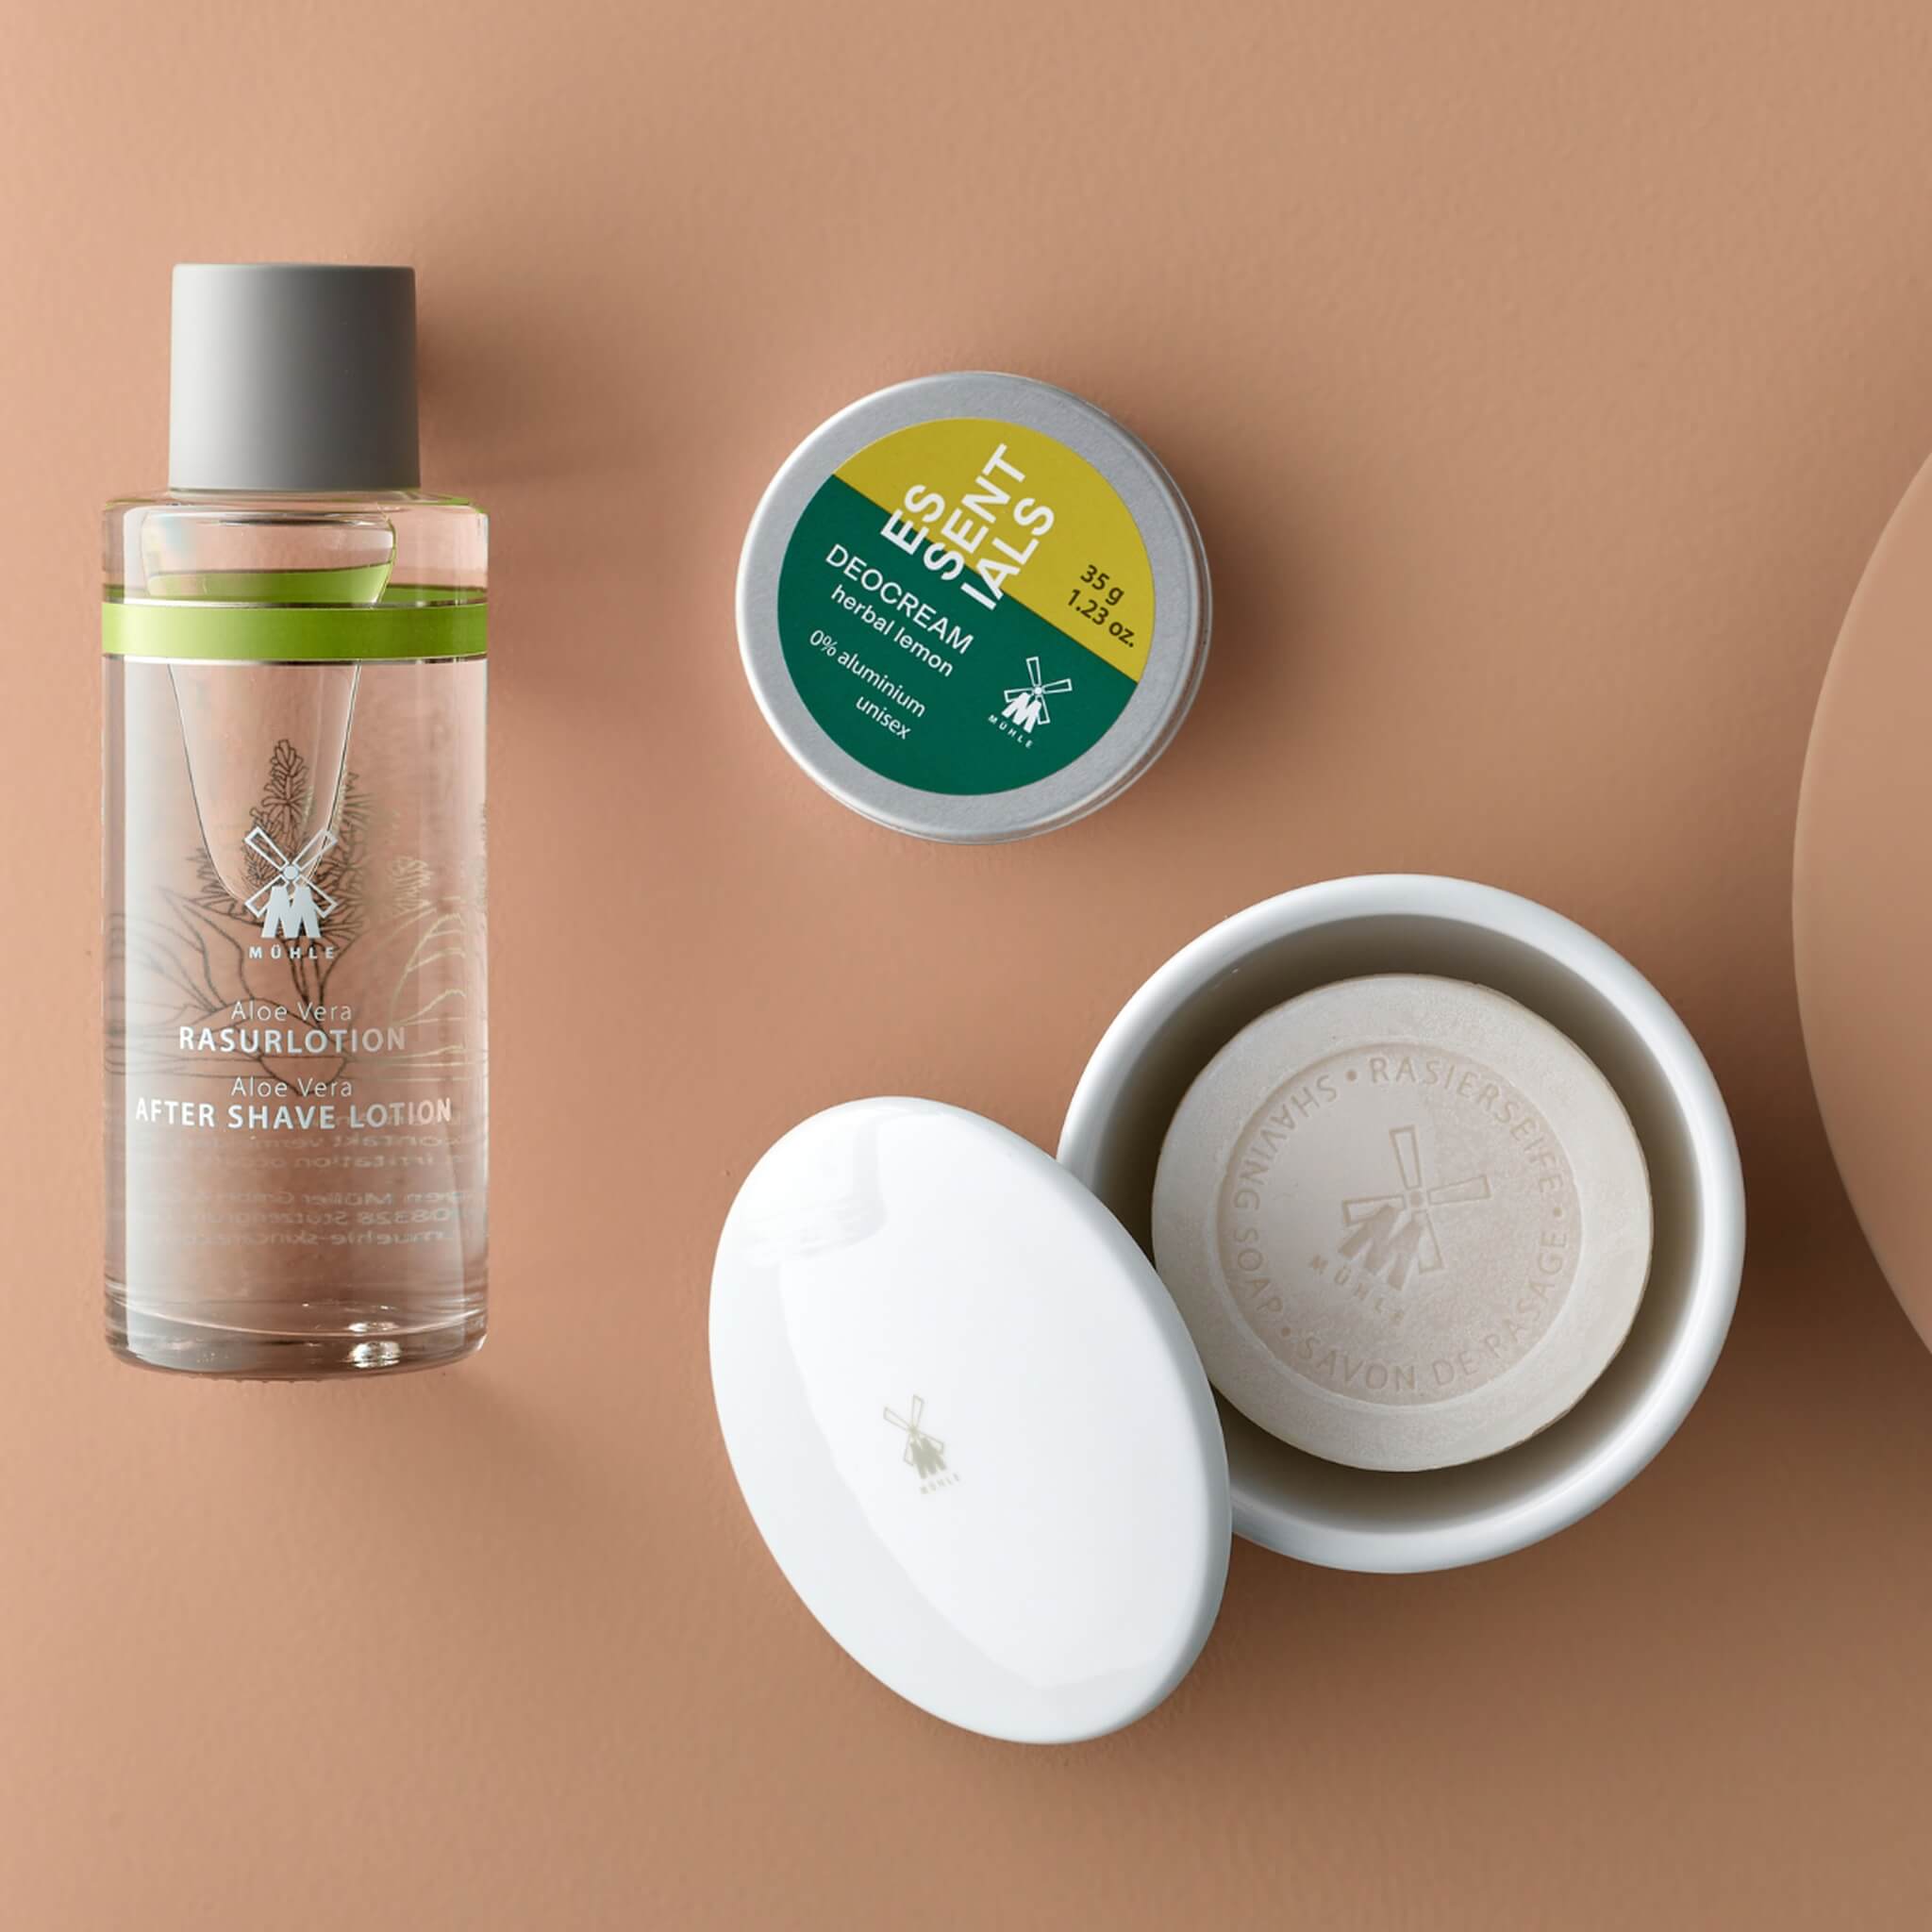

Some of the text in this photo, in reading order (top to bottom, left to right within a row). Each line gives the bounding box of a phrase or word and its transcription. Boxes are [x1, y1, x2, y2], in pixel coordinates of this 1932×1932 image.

[880, 484, 945, 556] ES
[924, 443, 1026, 581] SENT
[960, 496, 1055, 611] IALS
[1079, 564, 1124, 606] 35 g
[824, 543, 974, 655] DEOCREAM
[830, 584, 955, 678] herbal lemon
[1066, 589, 1135, 648] 1.23 oz.
[809, 629, 926, 719] 0% aluminium
[856, 696, 911, 740] unisex
[248, 944, 335, 960] MÜHLE
[178, 1025, 406, 1054] RASURLOTION
[230, 1001, 353, 1022] Aloe Vera
[135, 1097, 215, 1129] AFTER
[227, 1104, 336, 1130] SHAVE
[350, 1096, 453, 1129] LOTION
[230, 1077, 353, 1098] Aloe Vera
[1370, 1056, 1564, 1194] RASIERSEIFE
[1233, 1074, 1338, 1314] SHAVING SOAP
[1296, 1231, 1568, 1391] SAVON DE RASAGE
